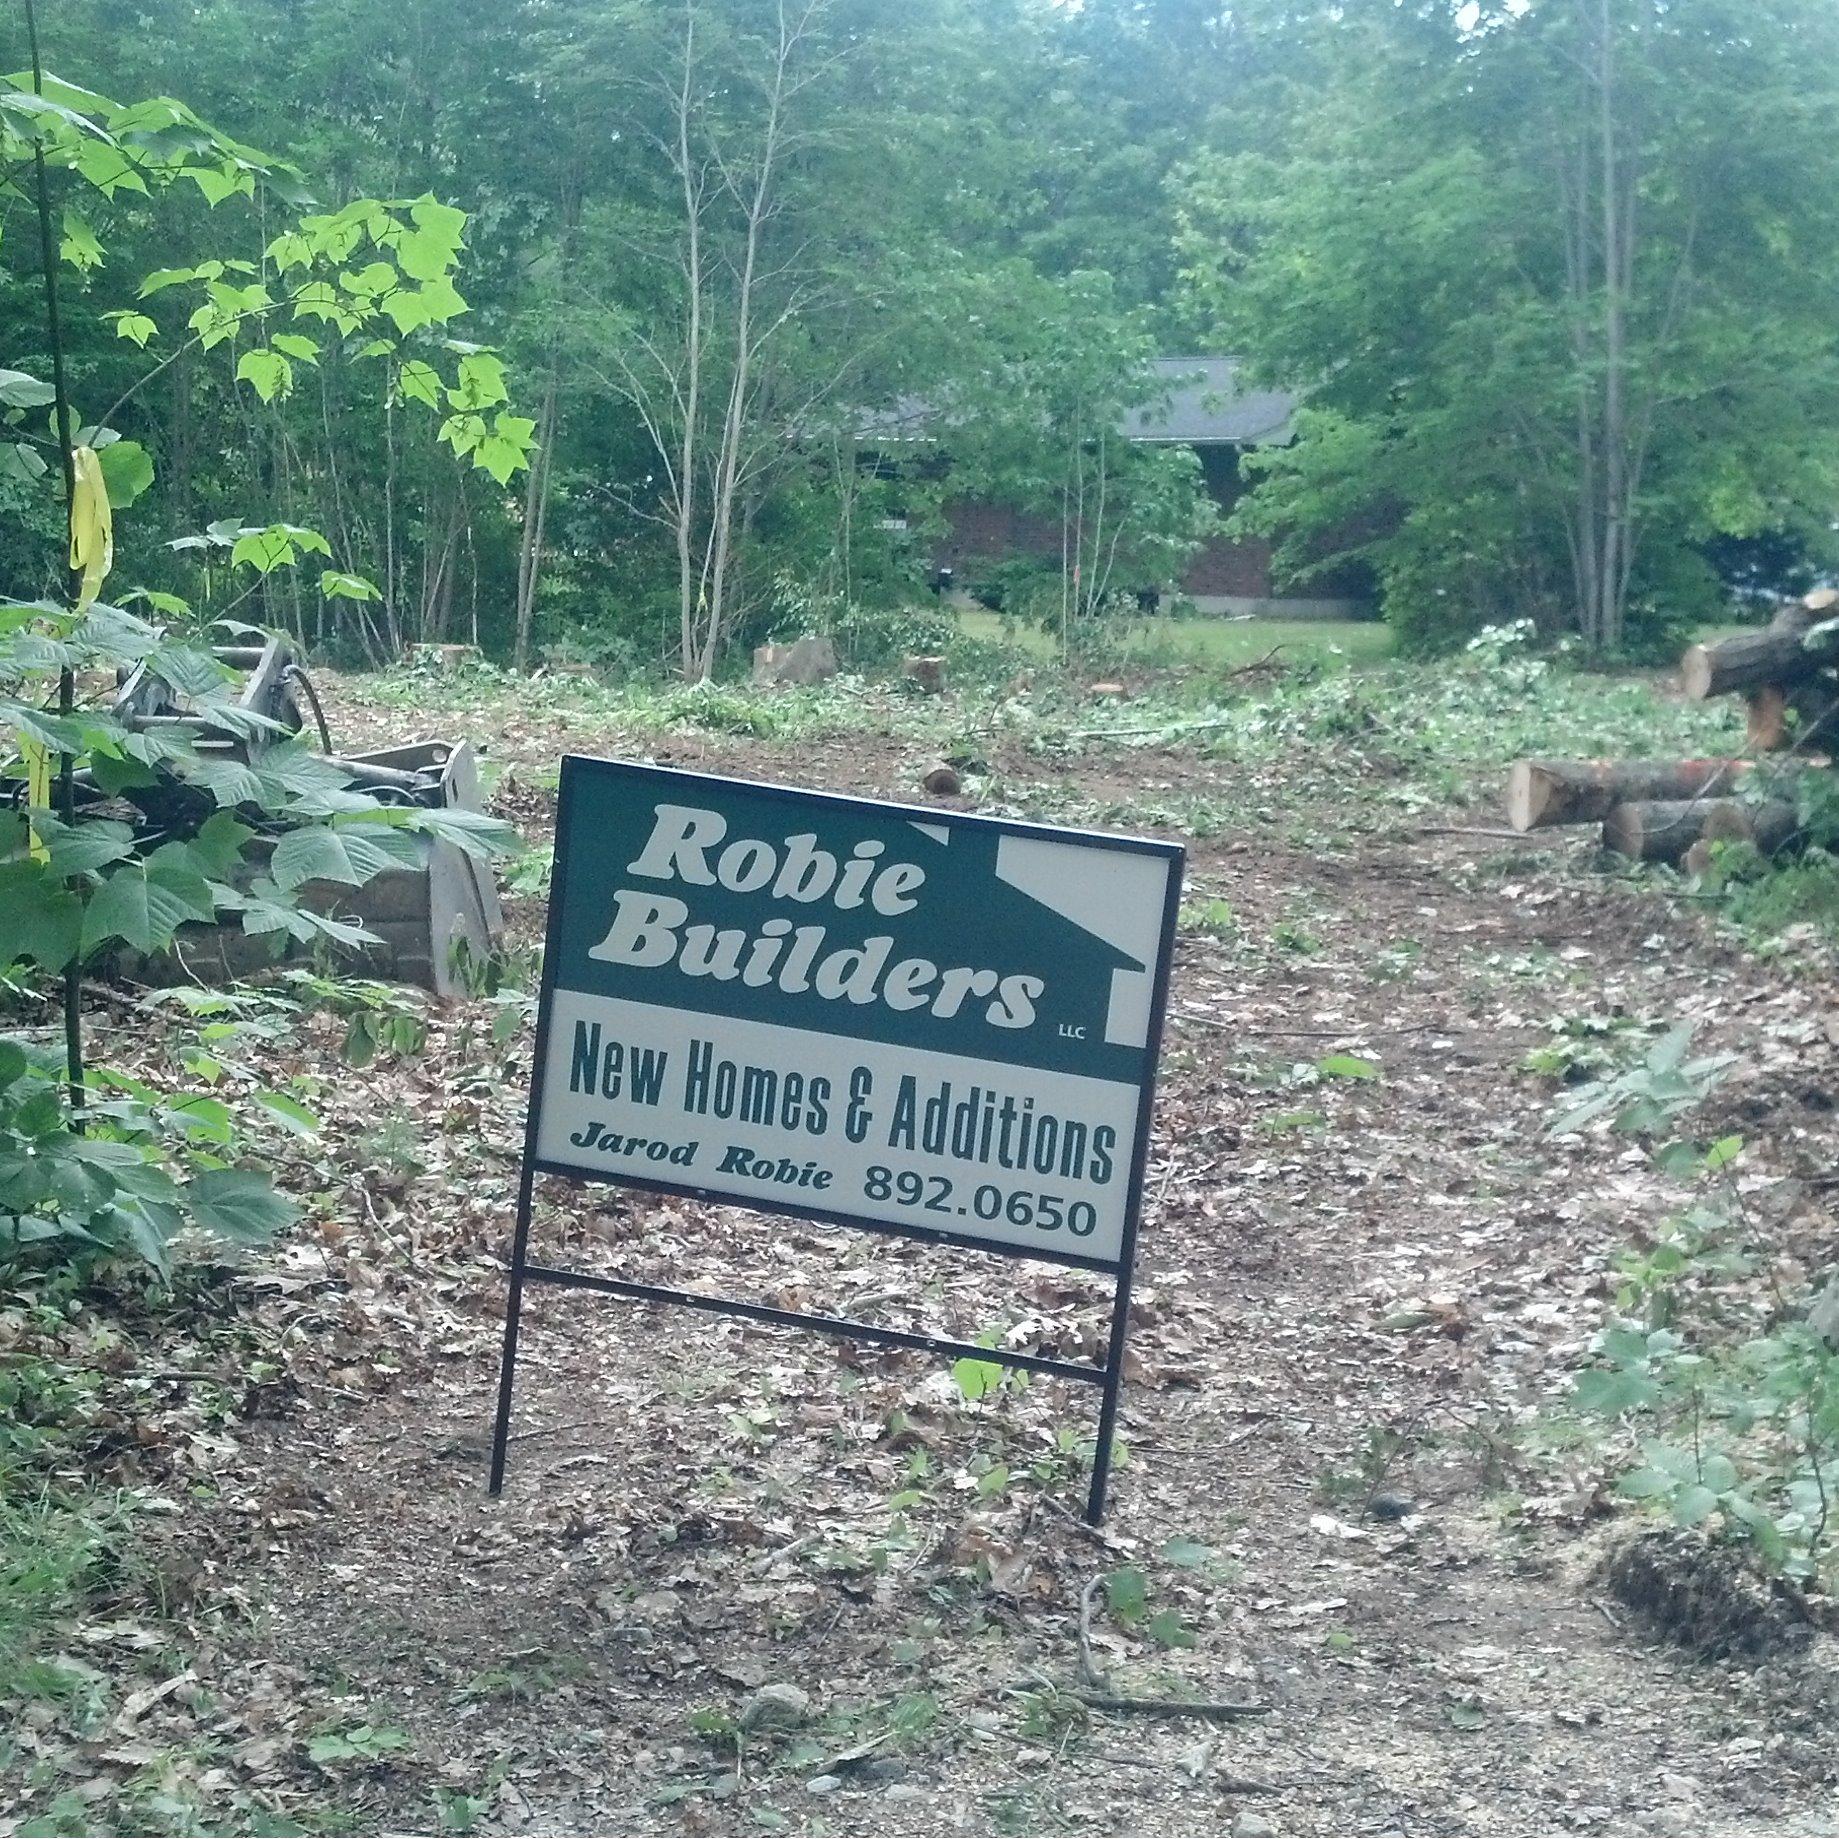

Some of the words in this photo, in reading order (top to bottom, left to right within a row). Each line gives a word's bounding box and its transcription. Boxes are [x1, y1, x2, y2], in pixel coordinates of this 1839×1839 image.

[627, 803, 926, 916] Robie
[588, 889, 1045, 1030] Builders
[1058, 1023, 1087, 1041] LLC
[569, 1020, 668, 1106] New
[683, 1039, 831, 1137] Homes
[845, 1065, 873, 1143] &
[888, 1074, 1116, 1185] Additions
[570, 1121, 699, 1167] Jarod
[716, 1145, 834, 1190] Robie
[863, 1166, 1098, 1237] 892.0650
